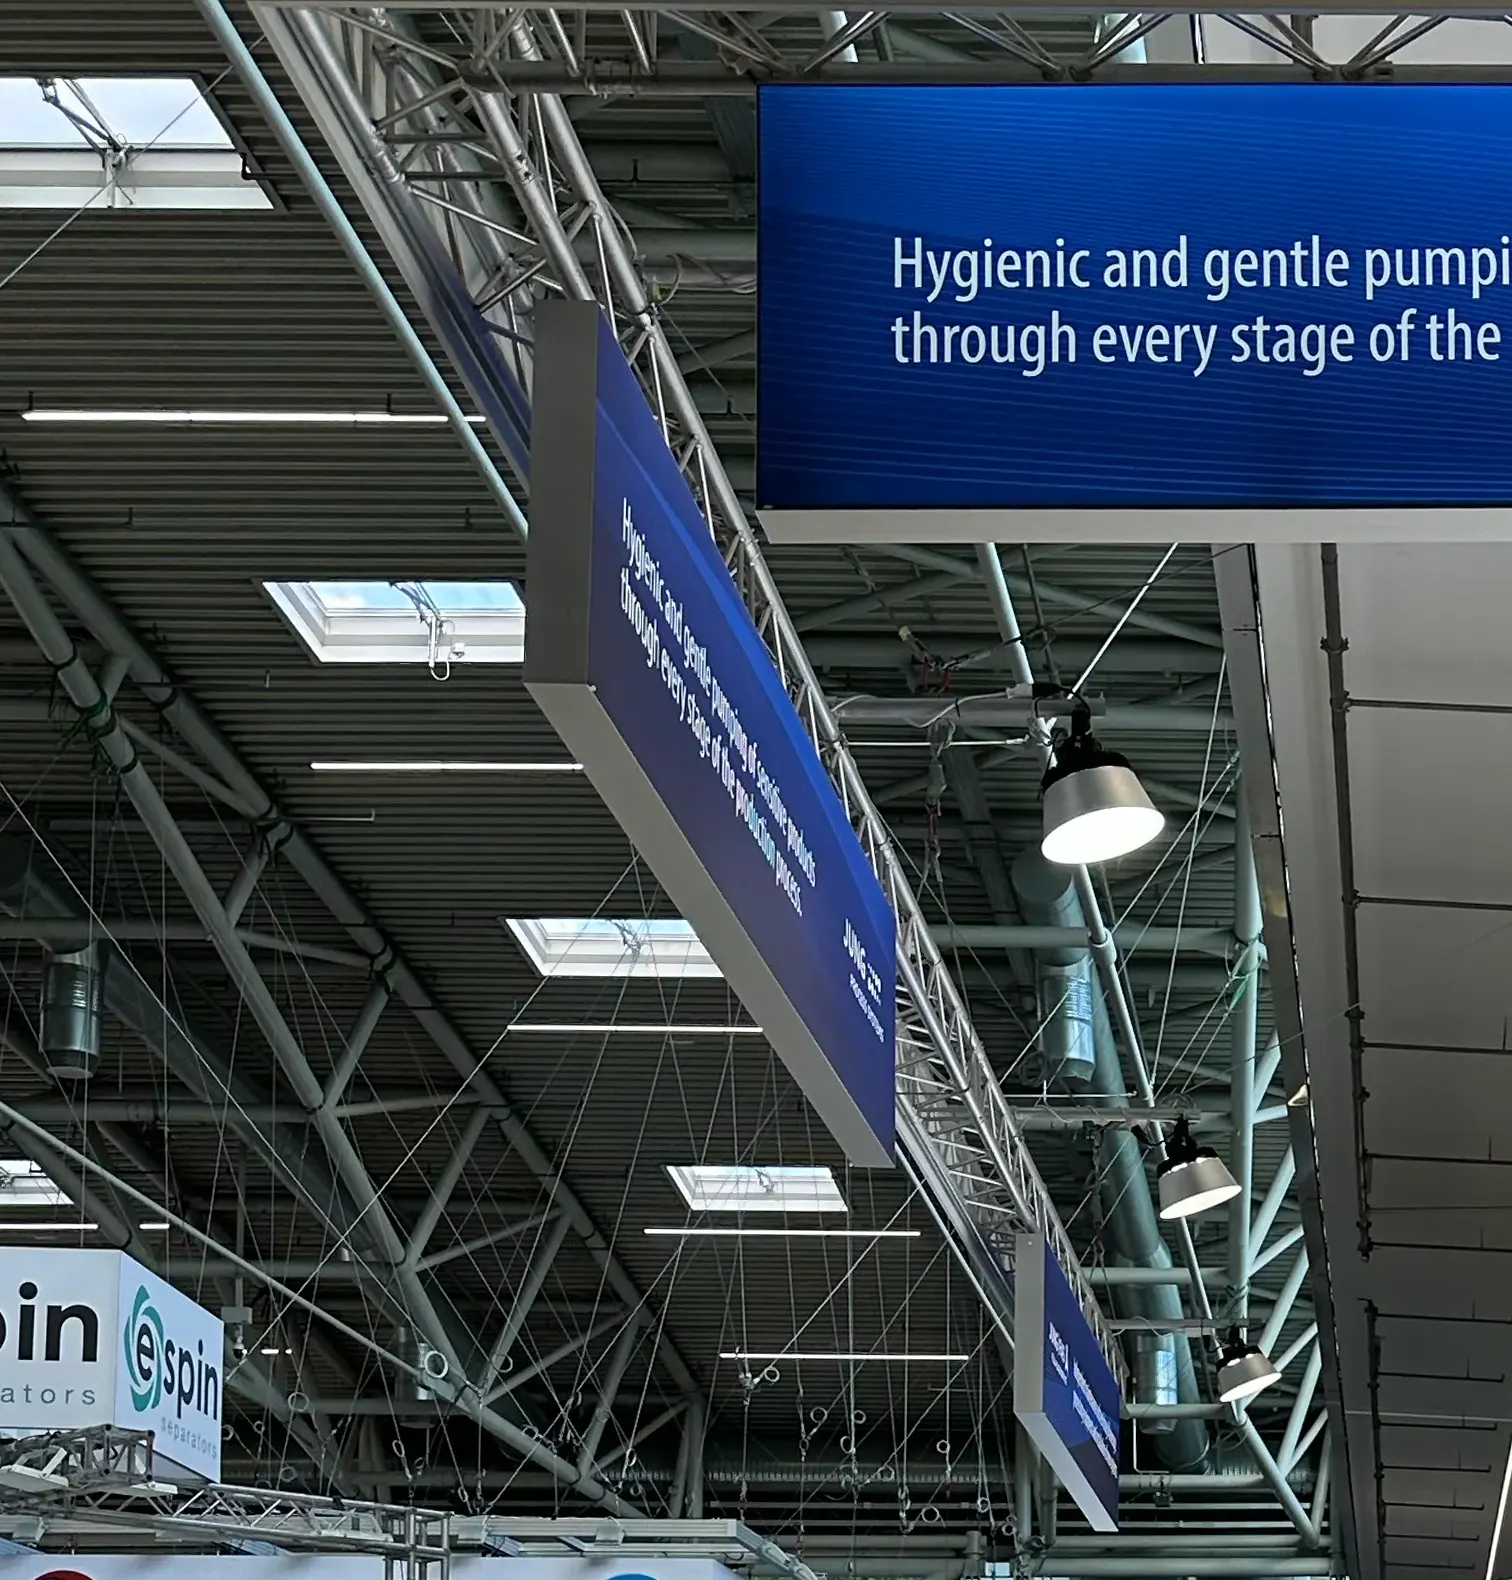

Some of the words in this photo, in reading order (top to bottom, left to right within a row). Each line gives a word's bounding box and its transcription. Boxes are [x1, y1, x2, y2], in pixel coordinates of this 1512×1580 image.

[894, 237, 1090, 304] Hygienic
[1103, 234, 1188, 288] and
[1203, 234, 1350, 302] gentle
[890, 310, 1076, 377] through
[1092, 324, 1218, 378] every
[1231, 315, 1355, 377] stage
[1369, 307, 1418, 362] of
[1425, 308, 1501, 361] the
[620, 567, 660, 669] through
[661, 648, 687, 722] every
[622, 496, 665, 611] Hygienic
[664, 589, 683, 646] and
[683, 625, 711, 697] gentle
[137, 1323, 218, 1421] espin
